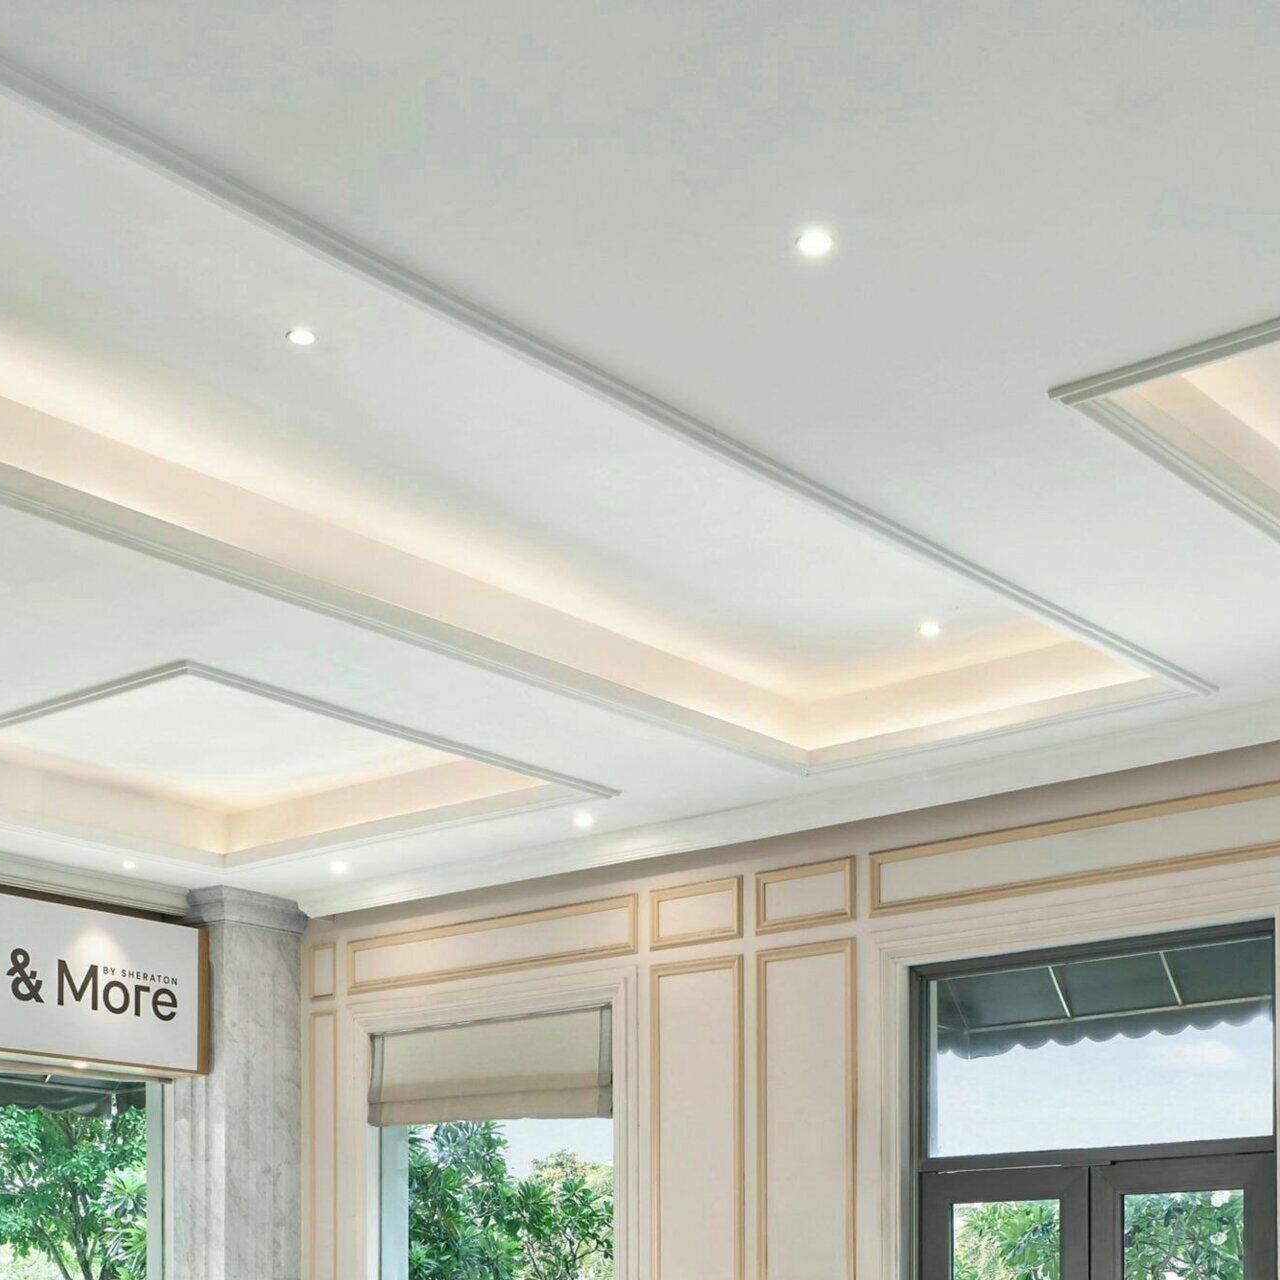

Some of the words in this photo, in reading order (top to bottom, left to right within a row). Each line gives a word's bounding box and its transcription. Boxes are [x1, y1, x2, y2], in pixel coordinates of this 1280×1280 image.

[57, 958, 178, 1022] More
[102, 965, 116, 976] BY
[121, 969, 178, 987] SHERATON
